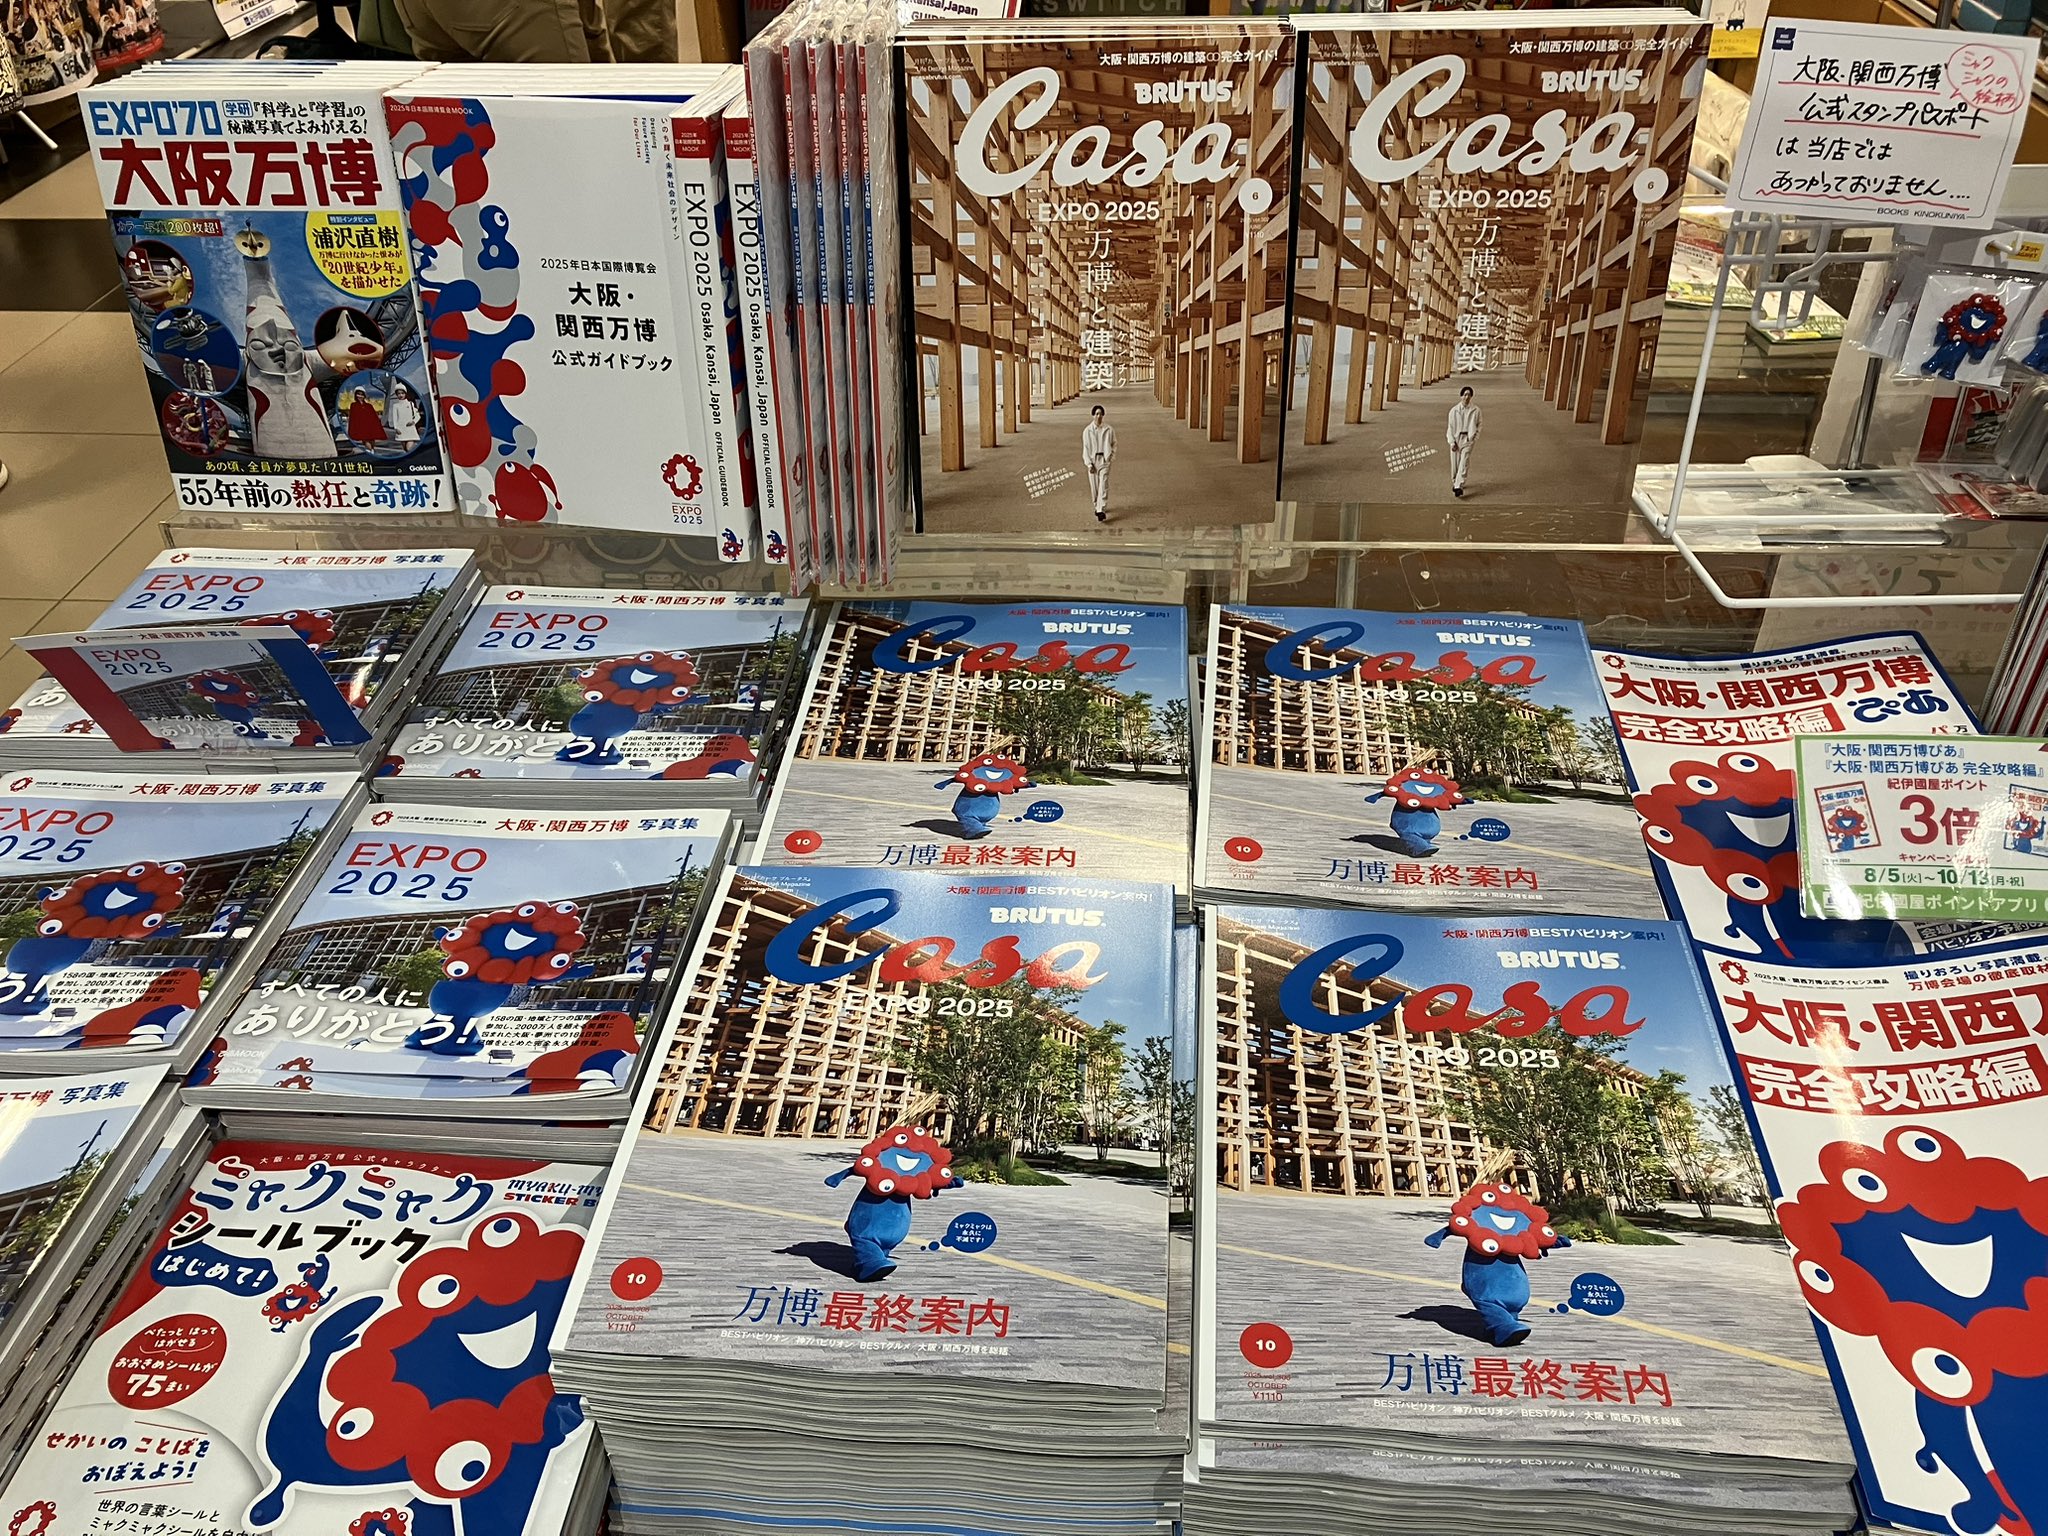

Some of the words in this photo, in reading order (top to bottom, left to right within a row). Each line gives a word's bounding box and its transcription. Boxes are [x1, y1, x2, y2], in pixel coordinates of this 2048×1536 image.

[942, 0, 979, 16] Japan
[1541, 68, 1644, 94] BRUTUS
[1134, 81, 1233, 105] BRUTUS
[1971, 89, 2020, 109] 絵柄
[88, 101, 223, 136] EXPO'70
[225, 101, 250, 116] 学研
[253, 101, 366, 119] 『科学』と『学習』の
[1350, 54, 1638, 183] Casa
[1799, 92, 1990, 130] 公式スタンプパスポート
[957, 66, 1240, 197] Casa
[99, 138, 382, 206] 大阪万博
[660, 116, 681, 241] いのち輝く未来社会のデザイン
[1252, 192, 1259, 200] 6
[1428, 189, 1492, 209] EXPO
[1496, 188, 1553, 208] 2025
[684, 183, 710, 247] EXPO
[735, 183, 760, 248] EXPO
[1038, 202, 1100, 222] EXPO
[1104, 200, 1160, 221] 2025
[1877, 207, 1910, 218] BOOKS
[1913, 210, 1967, 221] KINOKUNIYA
[312, 226, 400, 249] 浦沢直樹
[322, 260, 404, 275] 『20世紀少年』
[541, 258, 657, 275] 2025年日本国際博覧会
[694, 251, 713, 297] 2025
[341, 276, 402, 289] を描かせた
[569, 281, 635, 308] 大阪・
[1456, 216, 1503, 373] 万博と建築
[1084, 228, 1115, 391] 万博と建築
[555, 314, 657, 342] 関西万博
[701, 302, 713, 343] Osaka,
[552, 350, 673, 372] 公式ガイドブック
[705, 344, 718, 388] Kansai,
[1116, 330, 1128, 388] ケンチク
[709, 387, 722, 425] Japan
[714, 431, 724, 465] OFFICIAL
[205, 460, 374, 474] あの頃、全員が夢見た「21世紀」
[408, 464, 438, 473] Gakken
[179, 479, 441, 509] 55年前の熱狂と奇跡!
[717, 466, 730, 507] GUIDEBOOK
[672, 505, 702, 515] EXPO
[673, 515, 703, 525] 2025
[275, 554, 388, 566] 大阪・関西万博
[392, 553, 447, 565] 写真集
[143, 574, 265, 594] EXPO
[125, 592, 251, 613] 2025
[612, 593, 726, 607] 大阪・関西万博
[734, 595, 786, 607] 写真集
[488, 612, 610, 633] EXPO
[1043, 621, 1132, 635] BRUTUS
[477, 631, 599, 653] 2025
[871, 615, 1138, 673] Casa
[1436, 632, 1533, 648] BRUTUS
[90, 648, 162, 663] EXPO
[1264, 620, 1548, 686] Casa
[104, 661, 173, 677] 2025
[937, 678, 1002, 691] EXPO
[1006, 678, 1066, 691] 2025
[1603, 653, 1935, 712] 大阪・関西万博
[1339, 686, 1410, 701] EXPO
[1414, 688, 1478, 704] 2025
[1846, 688, 1950, 723] ぴあ
[422, 716, 566, 734] すべての人に
[1617, 706, 1836, 744] 完全攻略編
[406, 730, 612, 759] ありがとう!
[1824, 743, 1965, 759] 『大阪・関西万博ぴあ』
[1963, 762, 2046, 778] 完全攻略編』
[128, 782, 262, 797] 大阪・関西万博
[266, 780, 328, 795] 写真集
[1887, 778, 1988, 792] 紀伊國屋ポイント
[494, 817, 630, 833] 大阪・関西万博
[636, 815, 700, 832] 写真集
[796, 838, 811, 846] 10
[1235, 844, 1251, 854] 10
[345, 842, 489, 873] EXPO
[877, 844, 1078, 867] 万博最終案内
[1325, 857, 1539, 891] 万博最終案内
[328, 870, 474, 901] 2025
[989, 905, 1105, 927] BRUTUS
[764, 887, 1109, 989] Casa
[1441, 927, 1666, 942] 大阪・関西万博BESTパビリオン案内!
[1496, 950, 1620, 970] BRUTUS
[258, 979, 425, 1008] すべての人に
[1279, 932, 1647, 1038] Casa
[841, 992, 933, 1015] EXPO
[937, 996, 1014, 1018] 2025
[231, 1003, 479, 1046] ありがとう!
[1379, 1043, 1470, 1068] EXPO
[1477, 1048, 1562, 1071] 2025
[1745, 1050, 2042, 1112] 完全攻略編
[58, 1081, 130, 1105] 写真集
[259, 1153, 346, 1165] 大阪・関西万博
[353, 1153, 453, 1176] 公式キャラクター
[196, 1156, 495, 1226] ミャクミャク
[503, 1192, 579, 1206] STICKER
[168, 1213, 433, 1265] シールブック
[961, 1229, 983, 1237] 永久に
[156, 1255, 269, 1288] はじめて!
[627, 1272, 647, 1285] 10
[1576, 1283, 1617, 1292] ミャクミャクは
[731, 1284, 1011, 1338] 万博最終案内
[144, 1326, 183, 1337] ぺたっと
[189, 1326, 218, 1336] はって
[606, 1322, 637, 1333] ¥1110
[154, 1338, 197, 1348] はがせる
[1255, 1339, 1276, 1351] 10
[115, 1356, 214, 1374] おおきめシールが
[126, 1374, 190, 1397] 75まい
[1247, 1381, 1288, 1390] OCTOBER
[1371, 1351, 1673, 1408] 万博最終案内
[1252, 1391, 1283, 1402] ¥1110
[46, 1432, 128, 1450] せかいの
[134, 1437, 211, 1458] ことばを
[82, 1461, 198, 1483] おぼえよう!
[98, 1499, 221, 1523] 世界の言葉シールと
